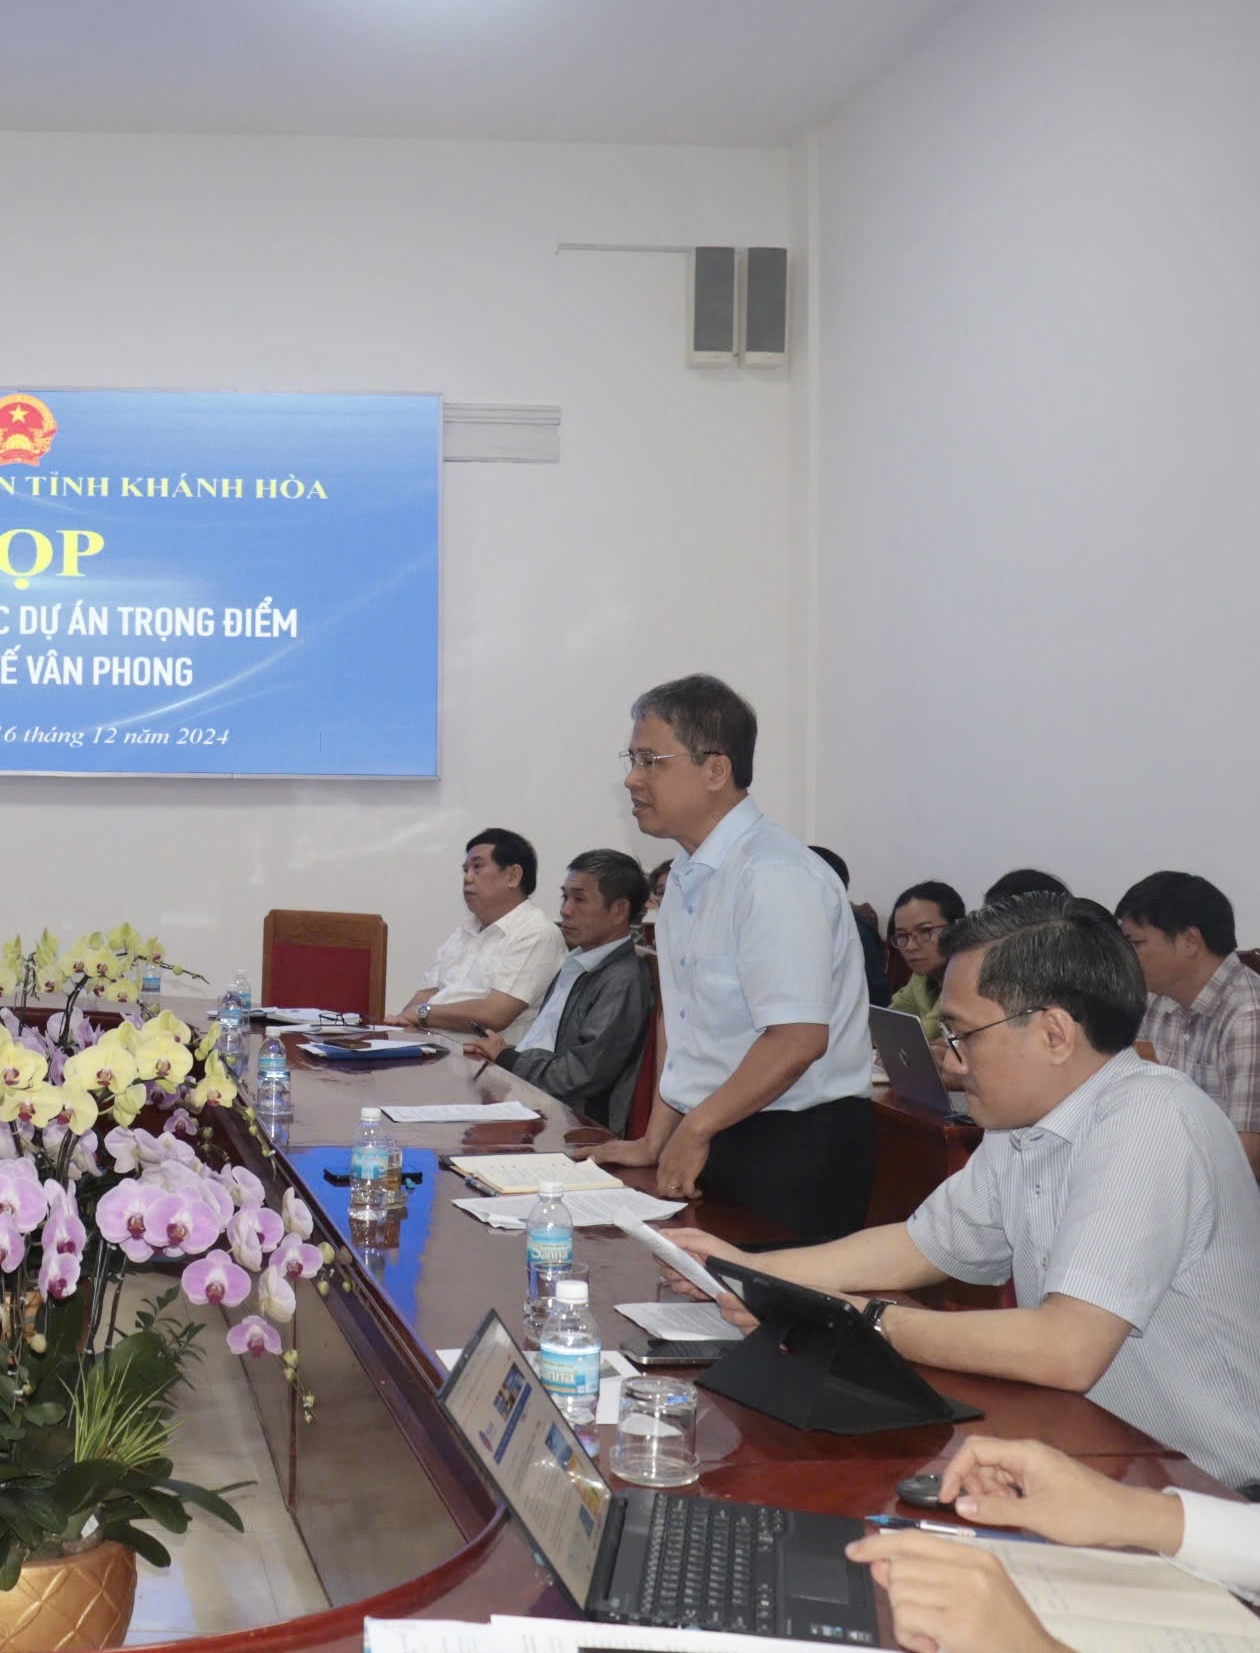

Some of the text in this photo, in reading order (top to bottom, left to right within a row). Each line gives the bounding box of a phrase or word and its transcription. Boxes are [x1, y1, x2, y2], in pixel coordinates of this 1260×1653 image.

[25, 471, 109, 496] TỈNH
[120, 473, 244, 498] KHÁNH
[255, 474, 329, 500] HÒA
[19, 603, 62, 641] DỰ
[67, 599, 108, 636] ÁN
[117, 606, 215, 642] TRỌNG
[222, 596, 298, 638] ĐIỂM
[26, 649, 83, 686] VÂN
[92, 656, 193, 687] PHONG
[23, 725, 85, 748] tháng
[92, 726, 119, 744] 12
[123, 728, 170, 745] năm
[175, 727, 230, 746] 2024
